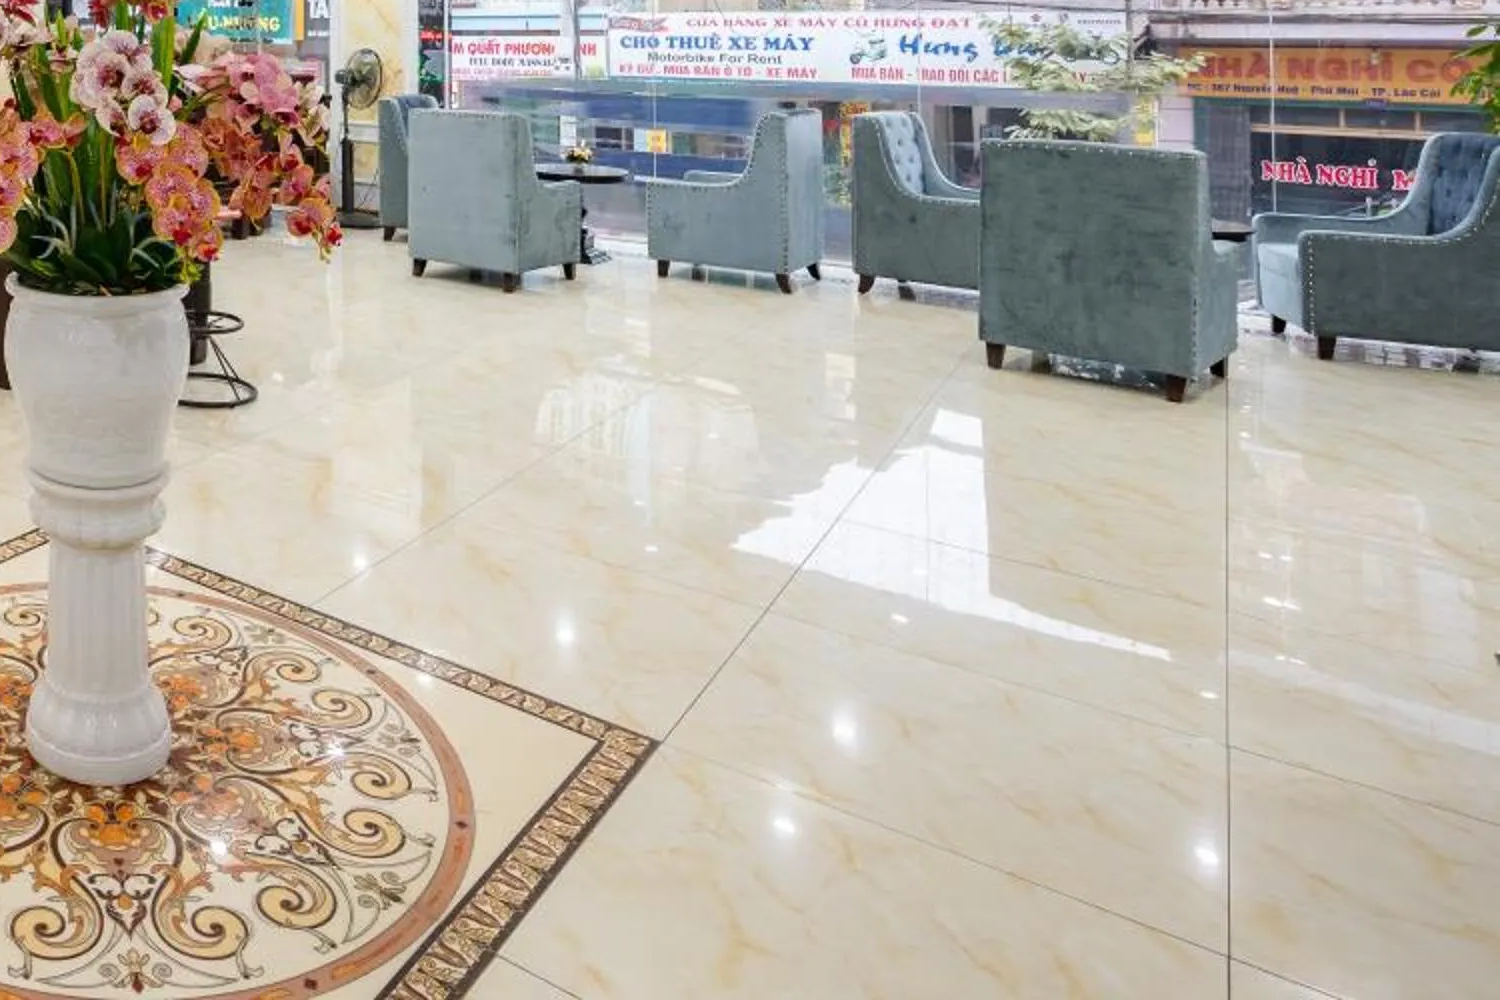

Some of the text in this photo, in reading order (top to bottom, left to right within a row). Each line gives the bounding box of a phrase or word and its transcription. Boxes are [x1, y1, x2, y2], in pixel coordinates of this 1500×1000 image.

[620, 35, 660, 49] CHO
[665, 32, 722, 50] THUÊ
[728, 36, 757, 50] XE
[1261, 156, 1312, 185] NHÀ
